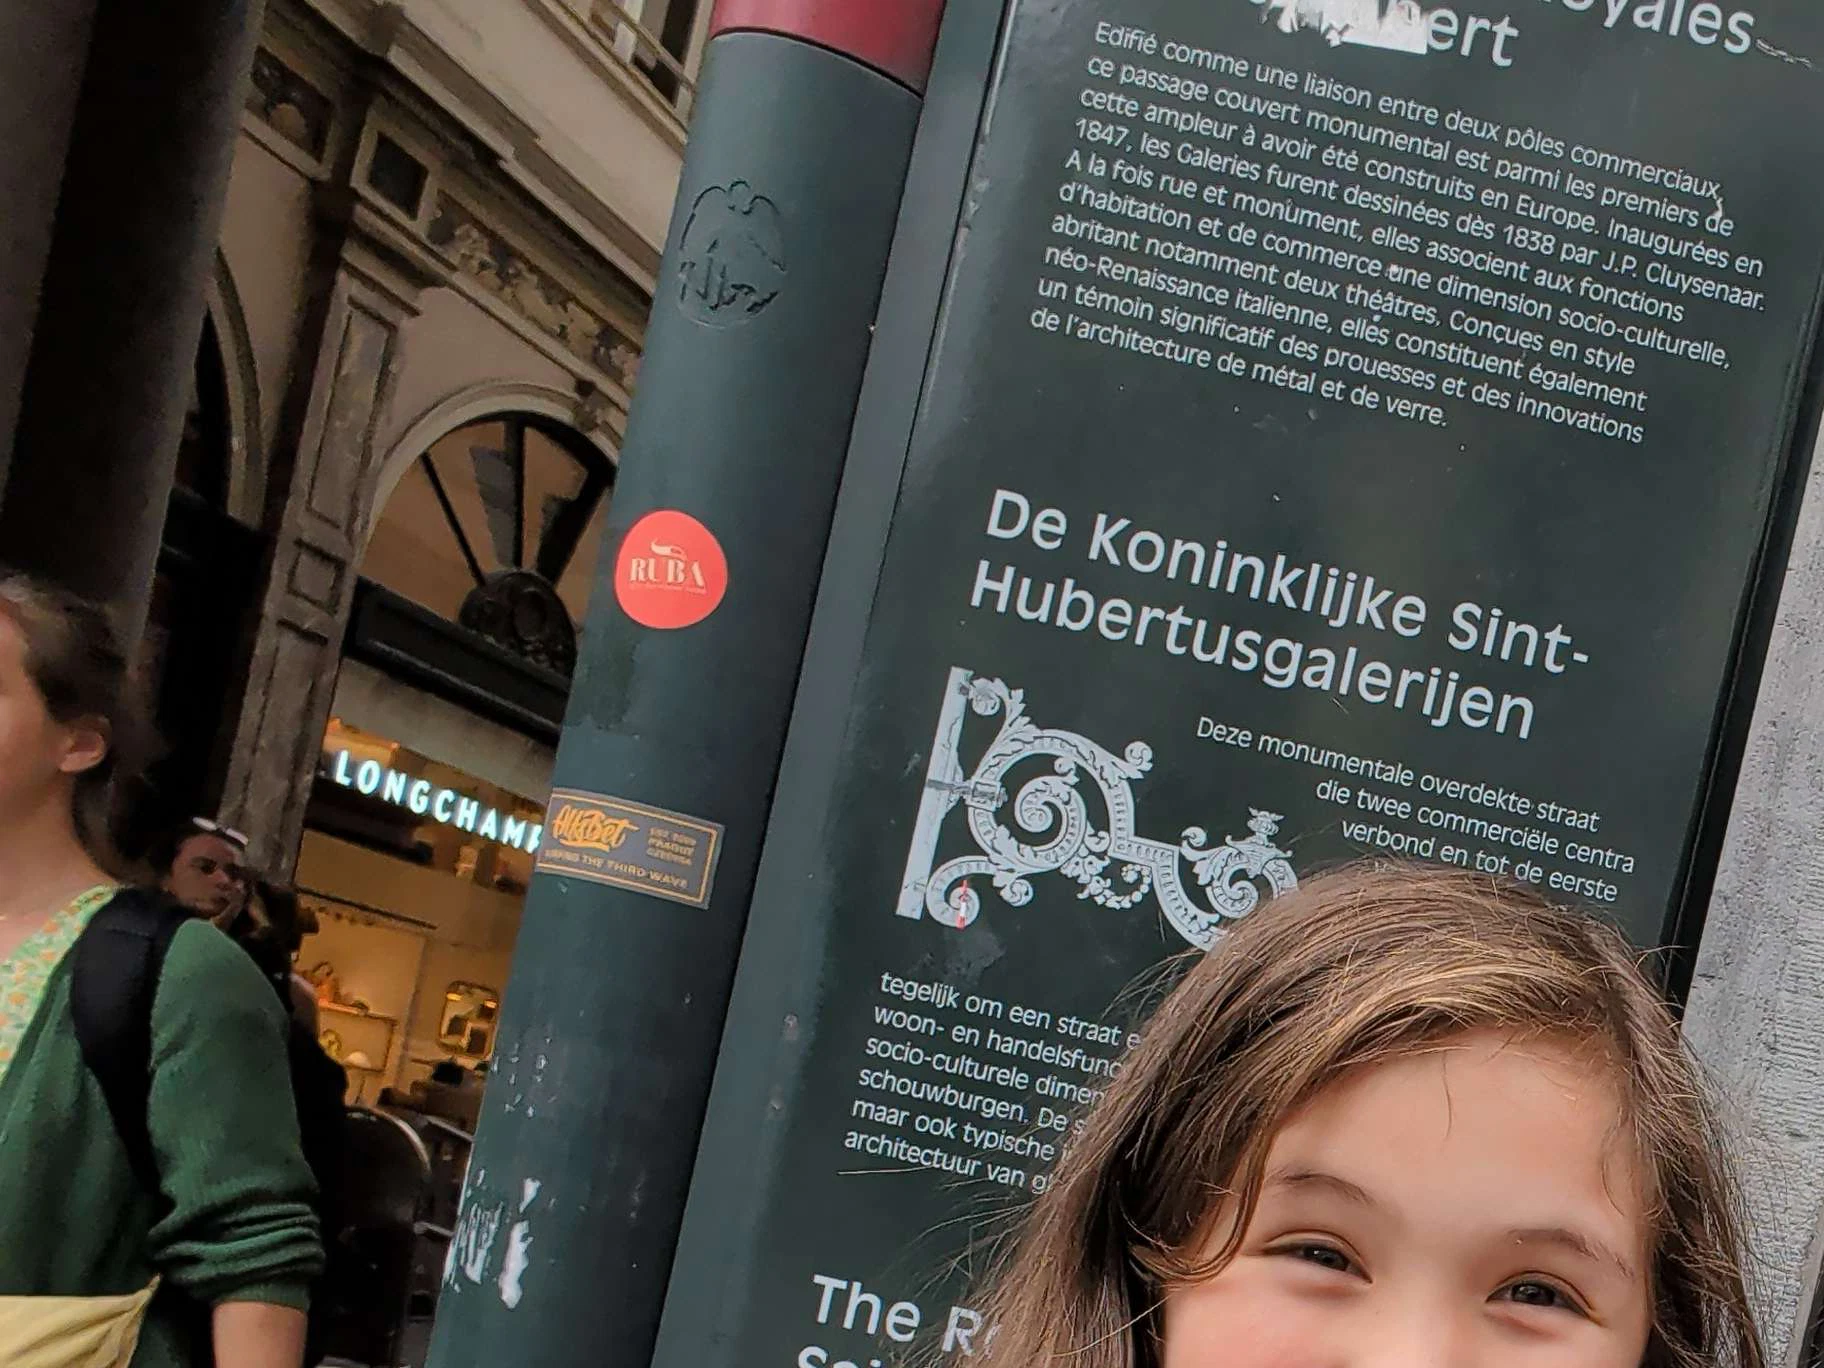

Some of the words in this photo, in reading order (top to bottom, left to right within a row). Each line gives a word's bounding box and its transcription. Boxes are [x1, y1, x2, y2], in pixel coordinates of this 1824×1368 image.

[1427, 8, 1519, 67] ert
[1562, 0, 1754, 53] yales
[1087, 56, 1116, 78] ce
[1119, 64, 1209, 102] passage
[1214, 87, 1302, 124] couvert
[1306, 109, 1451, 161] monumental
[1455, 148, 1491, 172] est
[1494, 159, 1561, 190] parmi
[1565, 172, 1596, 200] les
[1600, 186, 1700, 227] premiers
[1705, 214, 1734, 237] de
[1095, 21, 1158, 55] Edifié
[1162, 42, 1249, 77] comme
[1255, 64, 1299, 90] une
[1304, 72, 1372, 109] liaison
[1378, 96, 1439, 126] entre
[1445, 109, 1501, 142] deux
[1504, 127, 1565, 158] pôles
[1570, 144, 1723, 203] commerciaux,
[1065, 149, 1082, 172] A
[1086, 151, 1107, 177] la
[1112, 158, 1154, 188] fois
[1159, 174, 1198, 199] rue
[1202, 185, 1229, 206] et
[1232, 192, 1364, 243] monument,
[1371, 225, 1421, 254] elles
[1425, 240, 1531, 282] associent
[1533, 268, 1576, 294] aux
[1579, 276, 1685, 322] fonctions
[1076, 117, 1133, 152] 1847,
[1140, 131, 1171, 159] les
[1177, 142, 1262, 181] Galeries
[1266, 162, 1340, 201] furent
[1343, 184, 1451, 228] dessinées
[1456, 212, 1496, 240] dès
[1503, 223, 1556, 255] 1838
[1560, 242, 1600, 265] par
[1601, 250, 1637, 278] J.P.
[1645, 261, 1764, 311] Cluysenaar.
[1081, 88, 1139, 117] cette
[1143, 102, 1239, 141] ampleur
[1241, 122, 1256, 146] à
[1261, 133, 1318, 160] avoir
[1321, 144, 1359, 172] été
[1364, 159, 1476, 201] construits
[1480, 188, 1509, 210] en
[1515, 192, 1599, 235] Europe.
[1607, 217, 1730, 268] Inaugurées
[1734, 256, 1763, 277] en
[1045, 246, 1230, 306] néo-Renaissance
[1234, 287, 1333, 334] italienne,
[1340, 317, 1393, 346] elles
[1395, 332, 1527, 380] constituent
[1528, 362, 1648, 412] également
[1051, 213, 1141, 252] abritant
[1144, 237, 1280, 285] notamment
[1283, 269, 1341, 300] deux
[1345, 283, 1441, 327] théâtres,
[1449, 309, 1545, 354] Conçues
[1549, 339, 1578, 361] en
[1583, 347, 1635, 375] style
[1059, 181, 1192, 231] d’habitation
[1197, 217, 1224, 238] et
[1227, 221, 1257, 246] de
[1262, 230, 1383, 277] commerce
[1388, 264, 1432, 290] une
[1436, 274, 1552, 321] dimension
[1558, 307, 1729, 369] socio-culturelle,
[1030, 307, 1061, 331] de
[1065, 313, 1212, 368] l’architecture
[1217, 351, 1246, 376] de
[1251, 363, 1317, 394] métal
[1320, 380, 1347, 401] et
[1350, 384, 1380, 409] de
[1386, 395, 1447, 427] verre.
[1038, 278, 1069, 300] un
[1075, 284, 1154, 321] témoin
[1159, 305, 1276, 349] significatif
[1279, 334, 1320, 362] des
[1323, 346, 1437, 391] prouesses
[1441, 377, 1468, 398] et
[1471, 382, 1512, 409] des
[1516, 391, 1644, 443] innovations
[987, 489, 1067, 550] De
[1088, 513, 1426, 637] Koninklijke
[1448, 602, 1589, 673] Sint-
[970, 559, 1535, 738] Hubertusgalerijen
[1196, 716, 1253, 748] Deze
[1257, 734, 1414, 787] monumentale
[1420, 774, 1535, 817] overdekte
[1536, 801, 1601, 832] straat
[1316, 779, 1351, 805] die
[1357, 787, 1412, 823] twee
[1417, 806, 1560, 855] commerciële
[1565, 841, 1635, 873] centra
[607, 860, 647, 876] THIRD
[649, 871, 689, 889] WAVE
[1342, 820, 1436, 857] verbond
[1440, 845, 1468, 866] en
[1475, 850, 1511, 875] tot
[1515, 860, 1543, 884] de
[1549, 870, 1617, 902] eerste
[865, 1036, 1029, 1090] socio-culturele
[874, 1006, 945, 1036] woon-
[951, 1025, 981, 1047] en
[881, 972, 961, 1009] tegelijk
[965, 995, 1003, 1019] om
[1008, 1005, 1051, 1030] een
[1056, 1015, 1122, 1047] straat
[851, 1099, 911, 1127] maar
[914, 1114, 958, 1139] ook
[962, 1122, 1055, 1160] typische
[858, 1068, 1030, 1124] schouwburgen.
[1038, 1107, 1068, 1131] De
[844, 1130, 982, 1176] architectuur
[987, 1163, 1026, 1187] van
[813, 1274, 921, 1342] The
